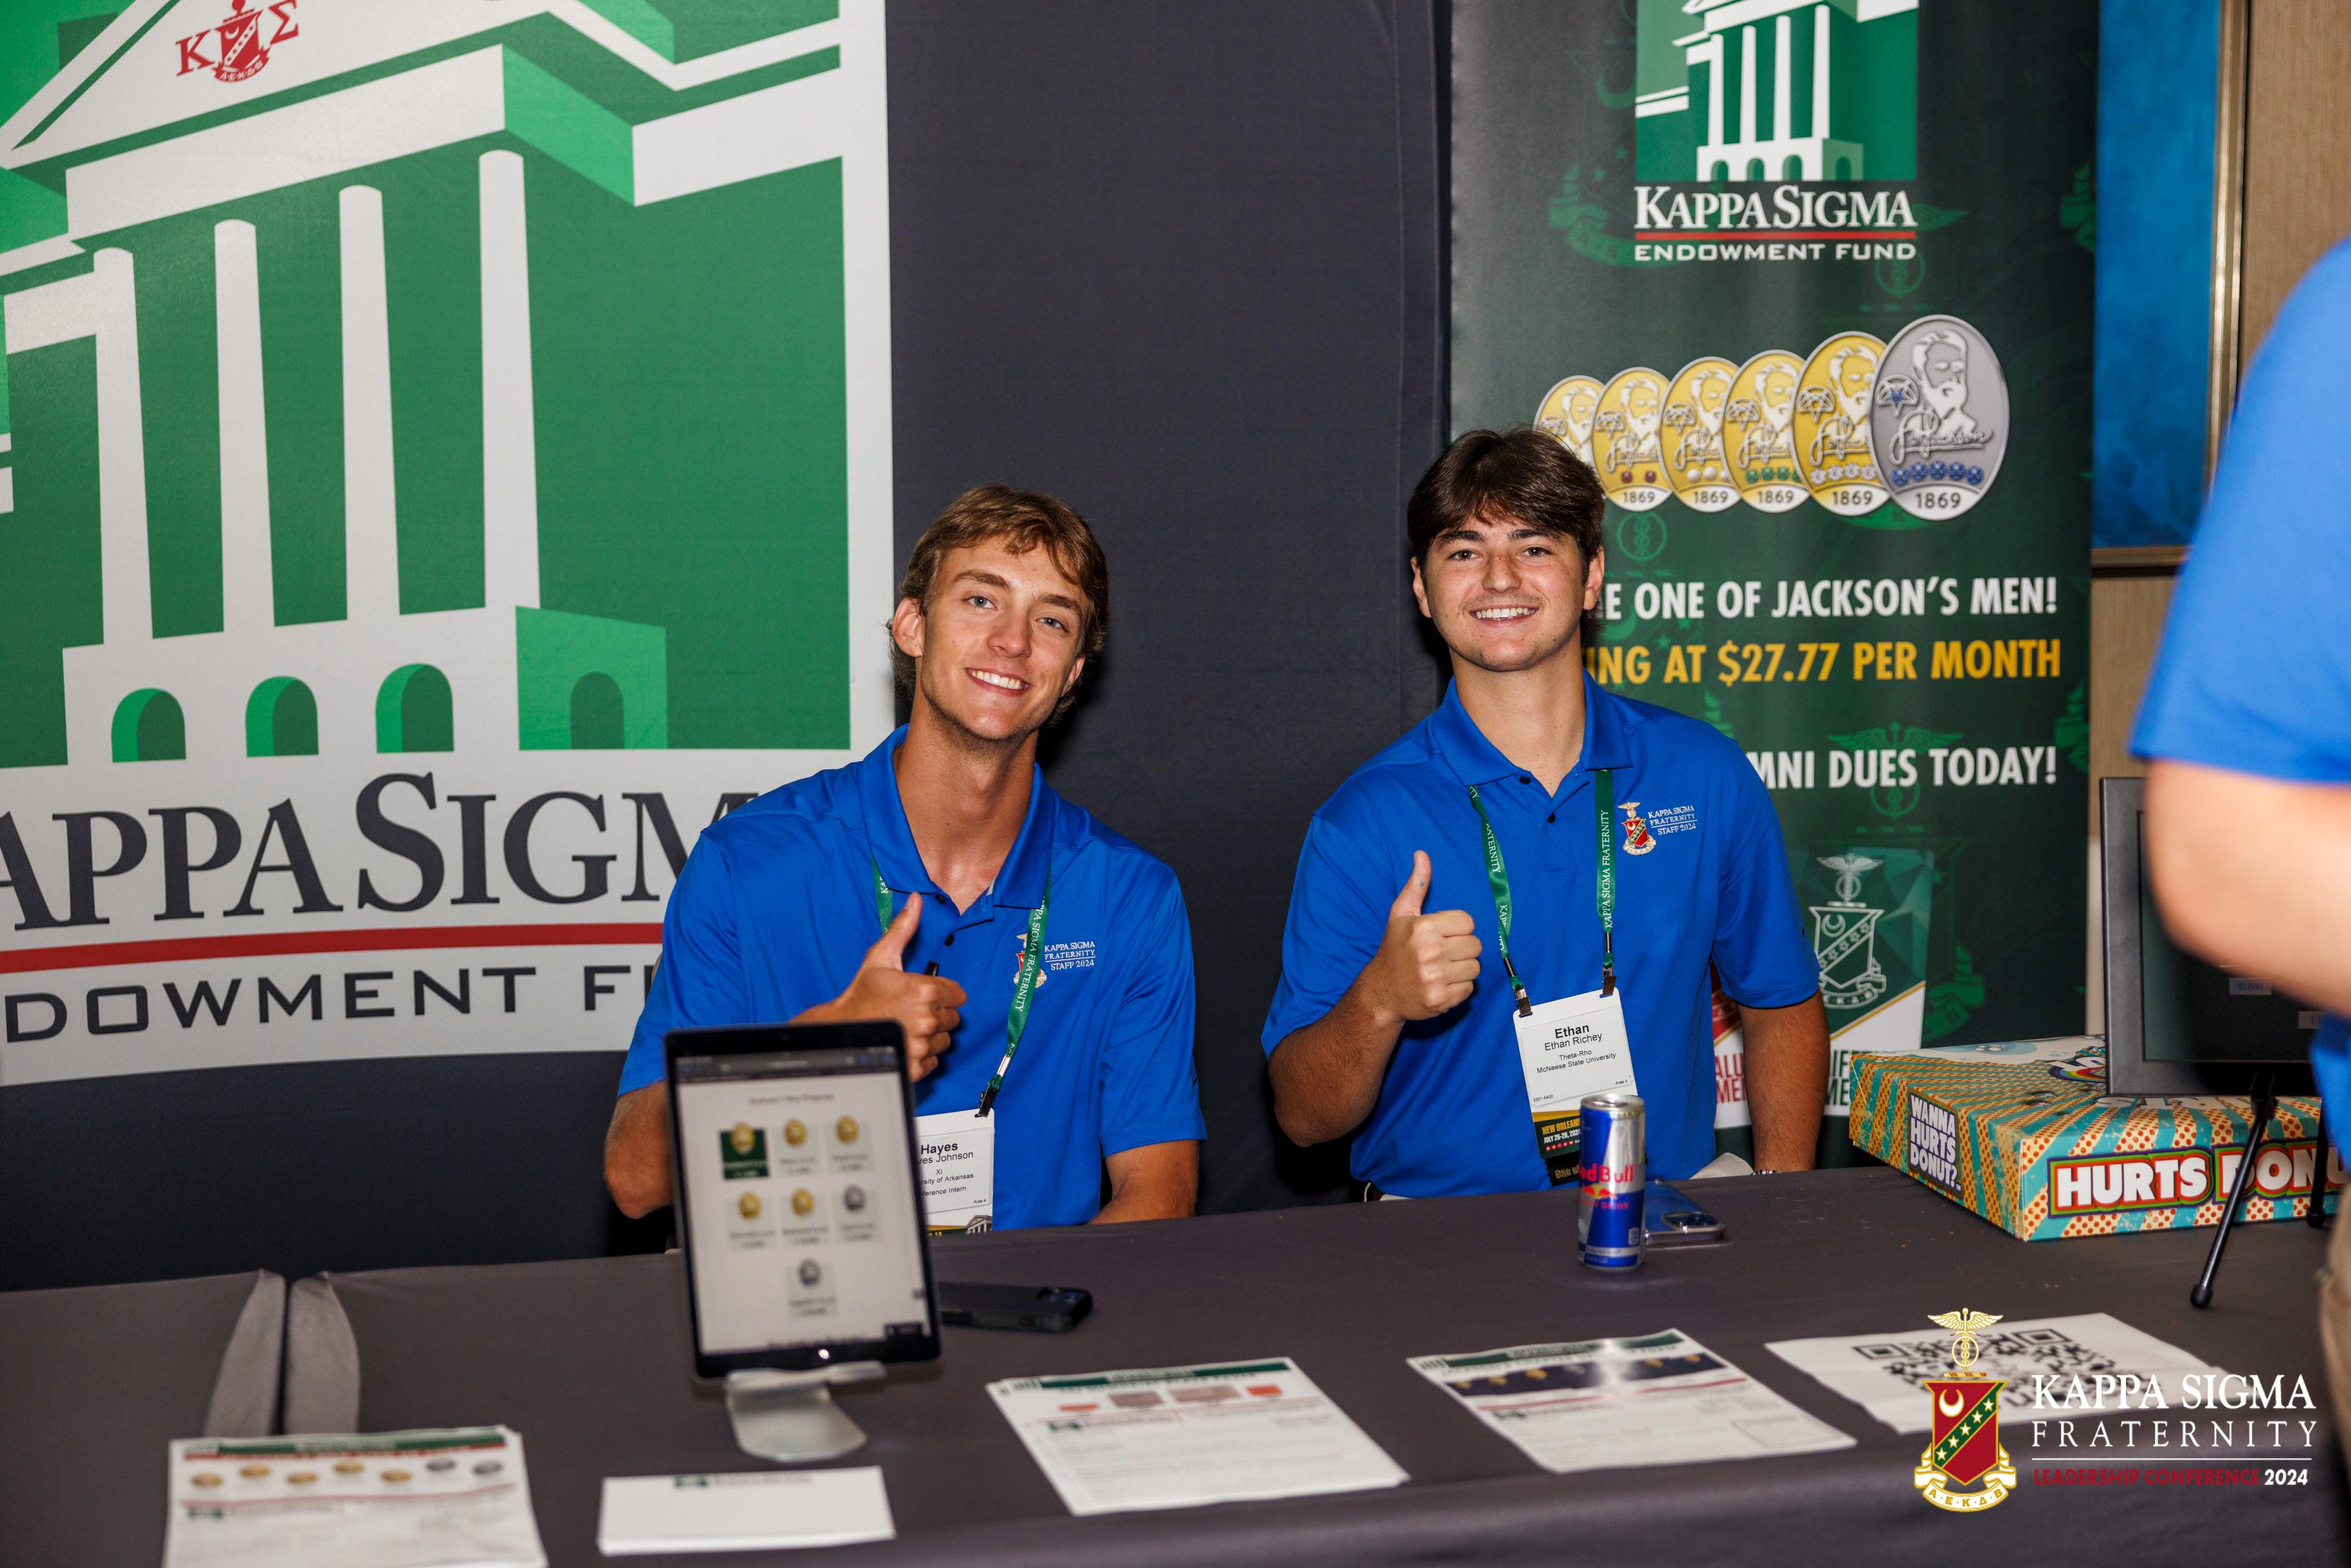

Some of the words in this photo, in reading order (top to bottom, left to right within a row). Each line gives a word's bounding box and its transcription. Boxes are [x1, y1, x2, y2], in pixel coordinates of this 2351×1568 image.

[1634, 186, 1770, 229] KAPPA
[1773, 185, 1918, 229] SIGMA
[1635, 243, 1826, 262] ENDOWMENT
[1836, 243, 1917, 260] FUND
[1623, 491, 1655, 504] 1869
[1694, 491, 1729, 504] 1869
[1758, 490, 1794, 504] 1869
[1833, 491, 1873, 505] 1869
[1917, 492, 1961, 509] 1869
[1634, 582, 1704, 620] ONE
[1717, 581, 1761, 618] OF
[1771, 576, 1960, 618] JACKSON'S
[1970, 577, 2057, 615] MEN!
[1582, 645, 1652, 686] ING
[1663, 645, 1707, 684] AT
[1717, 639, 1839, 687] $27.77
[1853, 641, 1918, 681] PER
[1931, 639, 2061, 679] MONTH
[1828, 748, 1918, 788] DUES
[1928, 746, 2057, 786] TODAY!
[1647, 808, 1672, 819] KAPPA
[1673, 805, 1694, 815] SIGMA
[1650, 813, 1695, 826] FRATERNITY
[1601, 810, 1610, 866] FRATERNITY
[1657, 826, 1679, 836] STAFF
[1680, 823, 1696, 832] 2024
[1602, 869, 1610, 899] SIGMA
[1603, 901, 1613, 929] KAPPA
[1030, 922, 1040, 951] SIGMA
[1044, 943, 1069, 952] KAPPA
[1070, 941, 1096, 950] SIGMA
[1044, 950, 1095, 960] FRATERNITY
[1051, 961, 1074, 971] STAFF
[1076, 959, 1094, 967] 2024
[584, 965, 655, 1011] F
[1015, 954, 1036, 1013] FRATERNITY
[1555, 1024, 1589, 1038] Ethan
[1545, 1040, 1570, 1051] Ethan
[1573, 1033, 1602, 1045] Richey
[1537, 1064, 1566, 1074] McNeese
[1586, 1053, 1616, 1064] University
[1559, 1050, 1592, 1061] Theta-Rho
[1716, 1076, 1747, 1103] ME
[1911, 1094, 1956, 1138] WANNA
[1542, 1124, 1556, 1135] NEW
[1543, 1135, 1554, 1144] JULY
[1554, 1132, 1570, 1141] 26-28,
[920, 1143, 958, 1155] Hayes
[1911, 1117, 1956, 1164] HURTS
[936, 1152, 973, 1162] Johnson
[1910, 1143, 1958, 1187] DONUT?
[945, 1173, 974, 1182] Arkansas
[1599, 1165, 1634, 1183] Bull
[2057, 1157, 2207, 1208] HURTS
